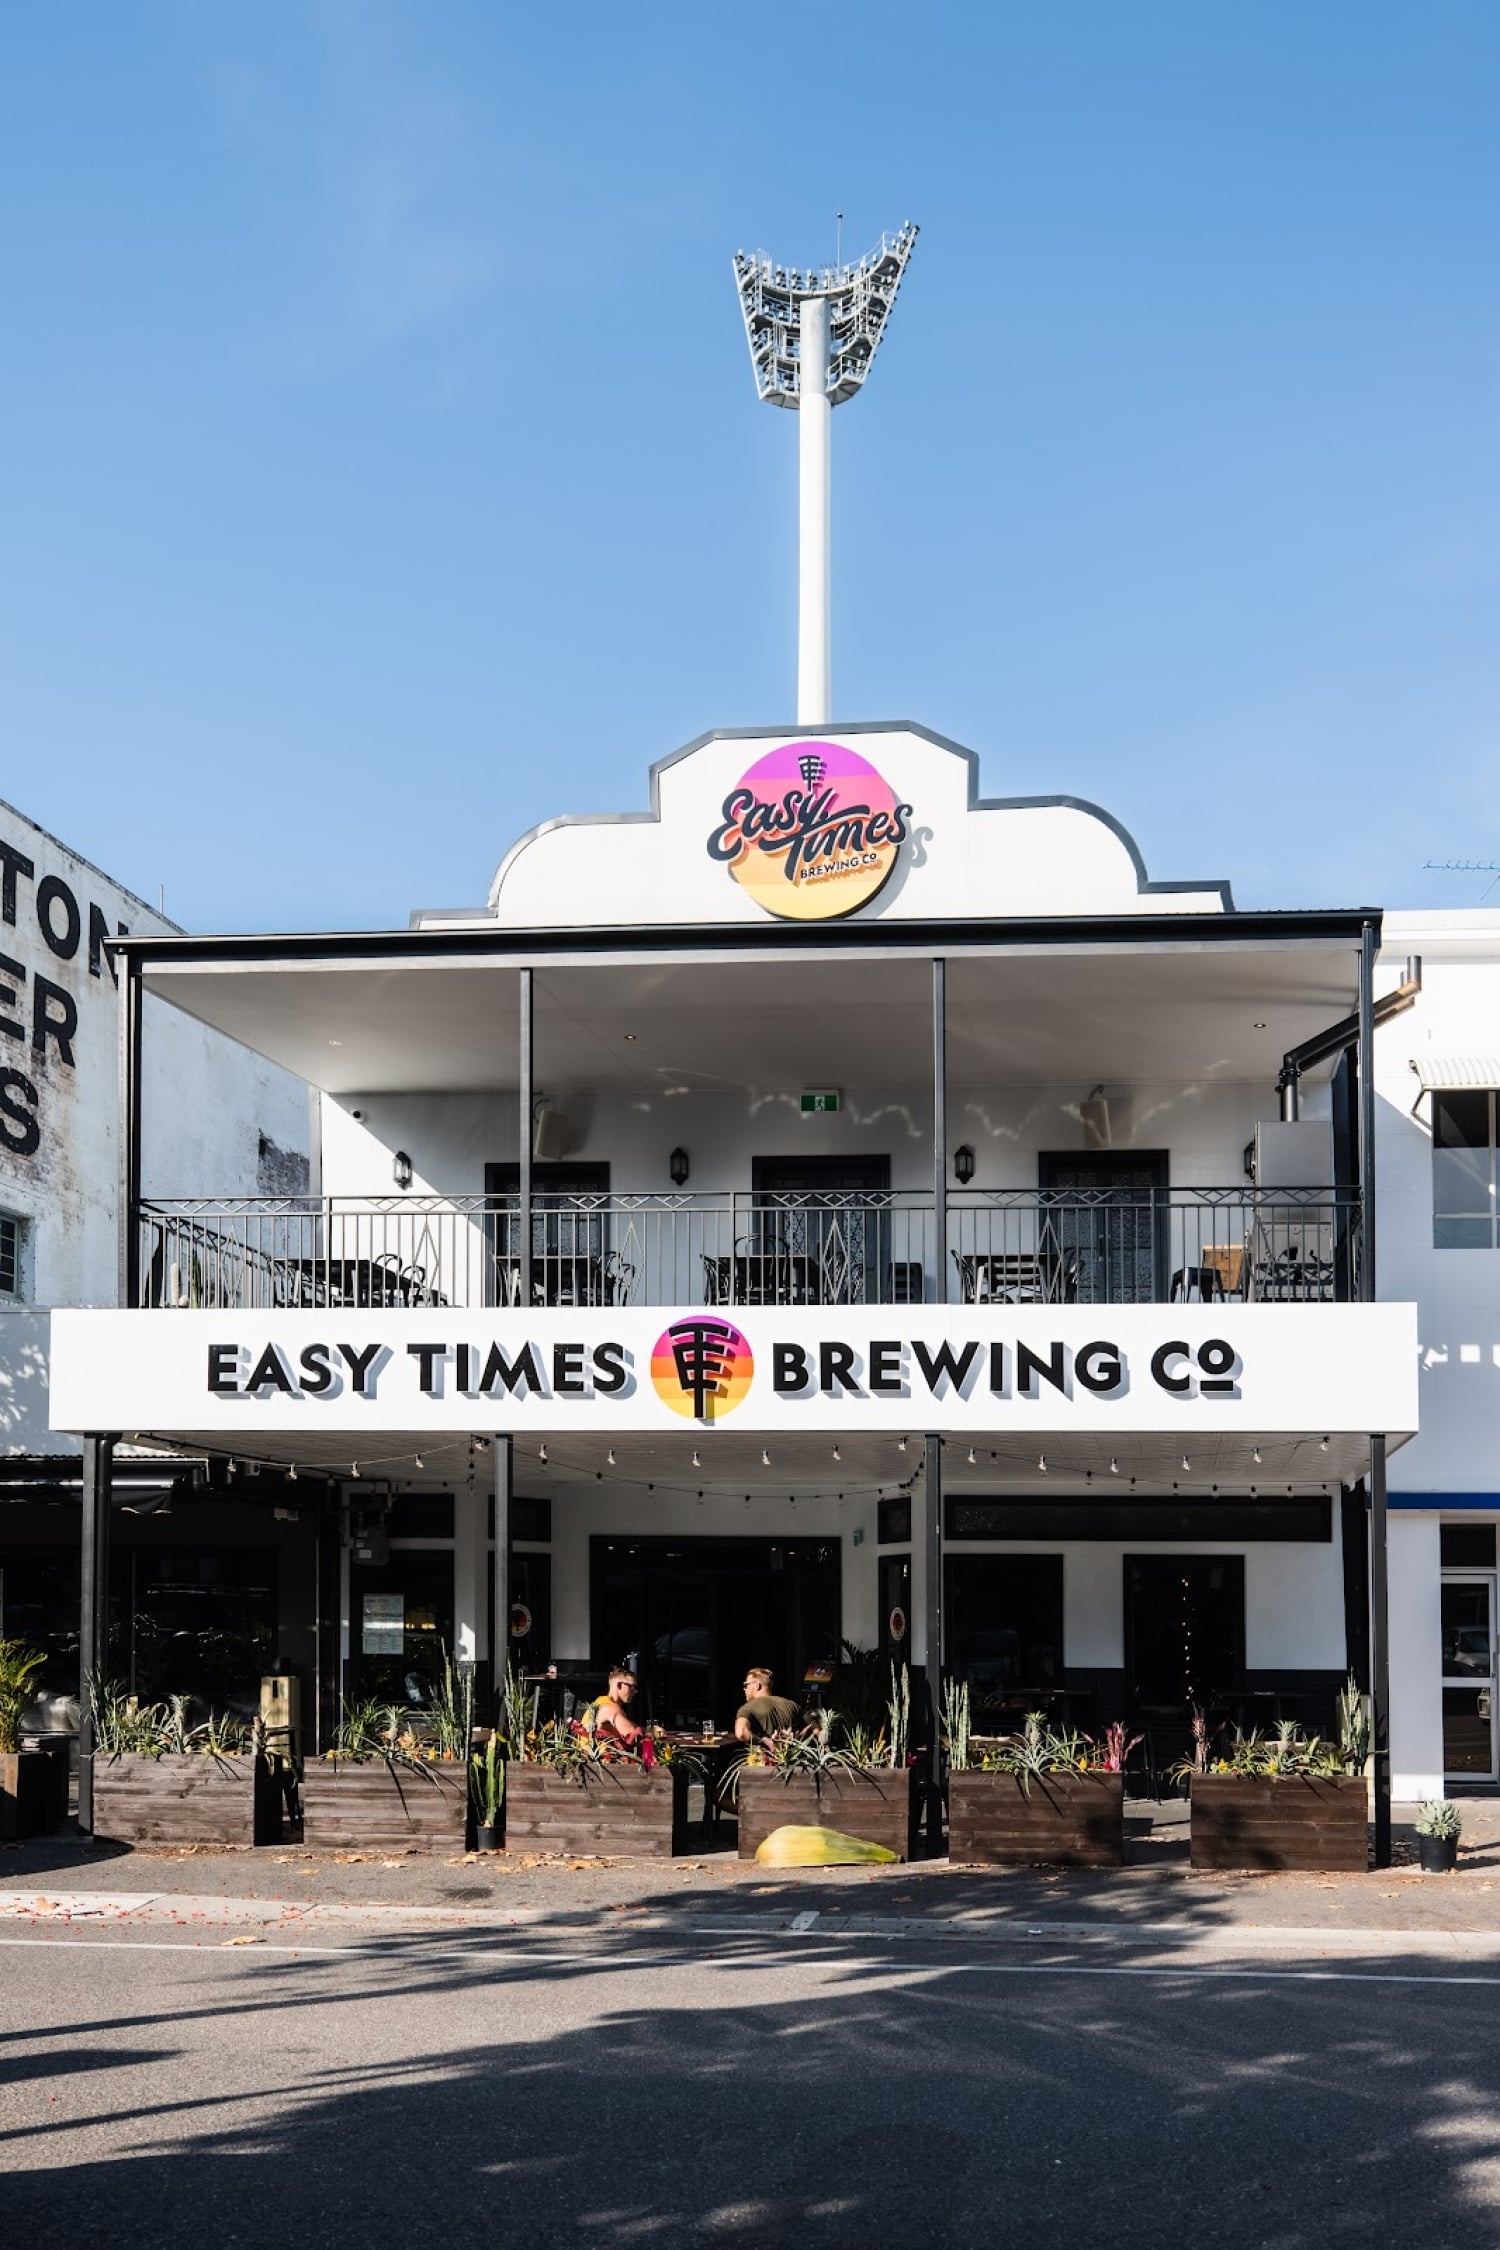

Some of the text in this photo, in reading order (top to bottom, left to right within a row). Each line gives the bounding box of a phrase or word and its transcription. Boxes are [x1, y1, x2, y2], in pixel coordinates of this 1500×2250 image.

[707, 788, 834, 861] Easy
[758, 804, 913, 881] Times
[801, 857, 859, 879] BREWING
[0, 1066, 40, 1157] S
[207, 1340, 383, 1393] EASY
[407, 1339, 628, 1393] TIMES
[772, 1338, 1122, 1394] BREWING
